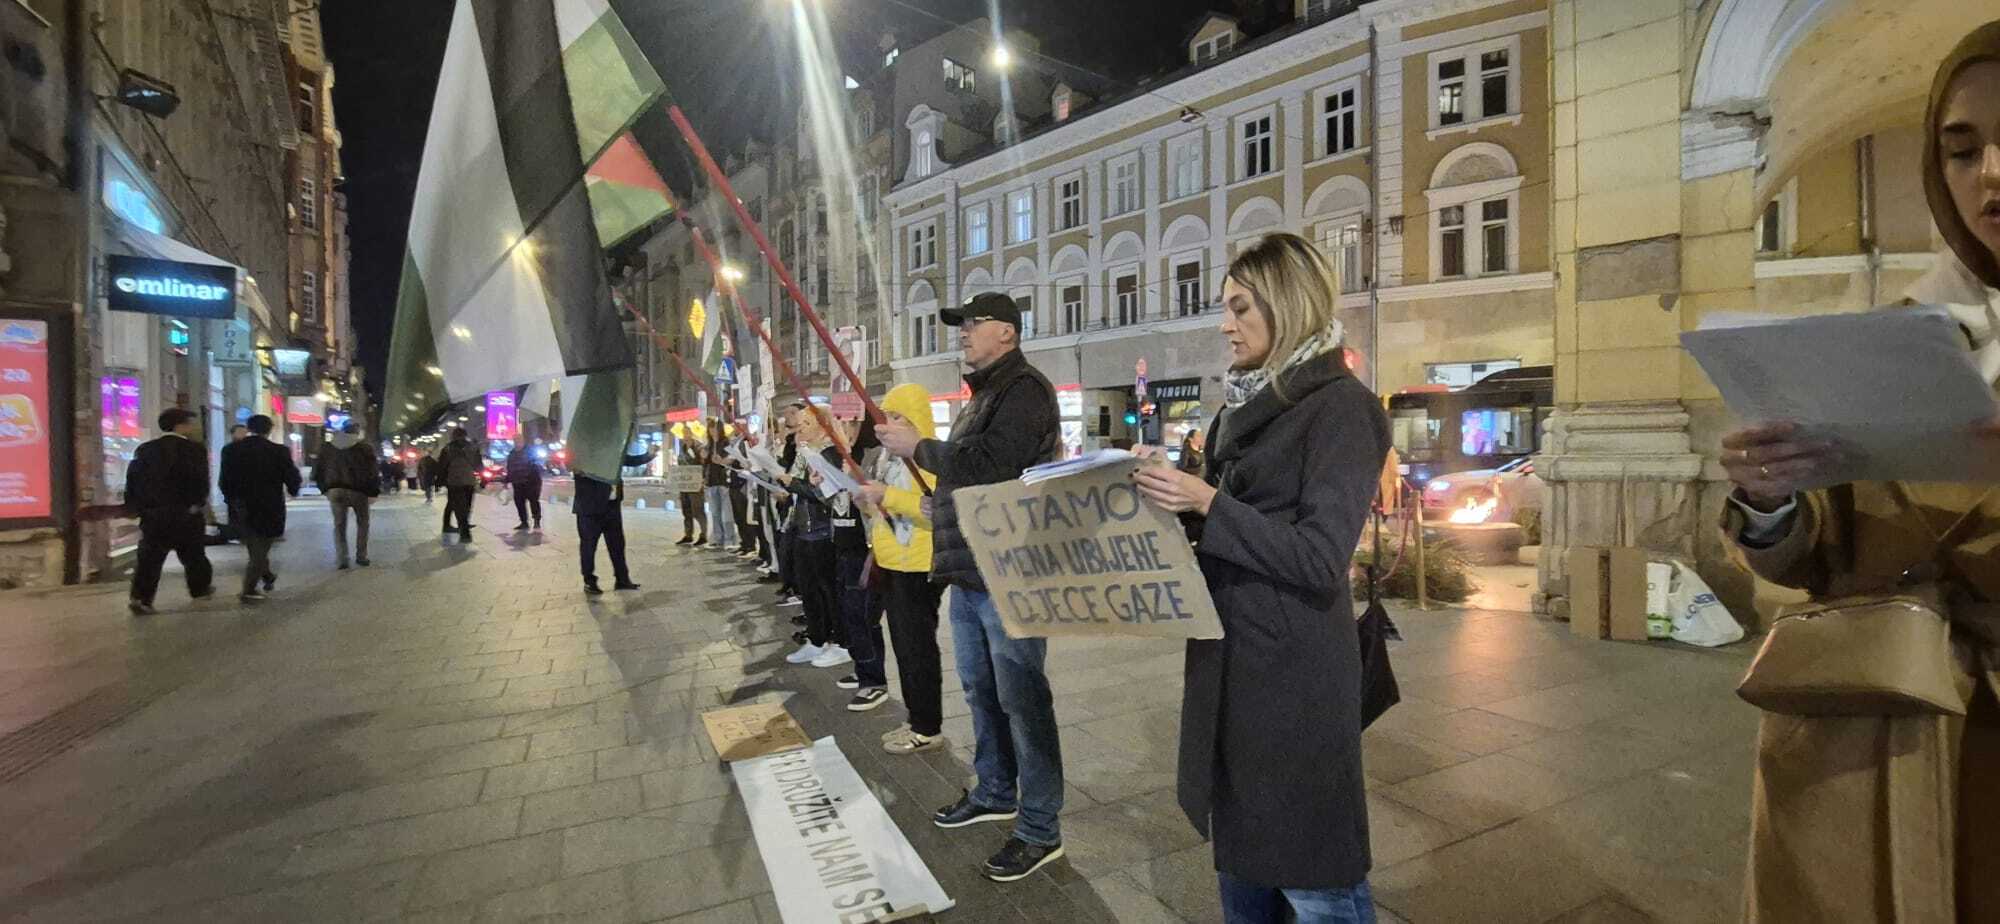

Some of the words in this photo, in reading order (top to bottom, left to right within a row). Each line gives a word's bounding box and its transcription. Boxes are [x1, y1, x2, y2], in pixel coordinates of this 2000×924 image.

[1156, 384, 1200, 399] PINGVIN
[974, 482, 1140, 537] ČITAMO
[989, 541, 1066, 578] IMENA
[1007, 585, 1109, 624] DJECE
[1104, 580, 1194, 624] GAZE
[806, 836, 874, 889] NAM
[832, 888, 895, 924] SE
